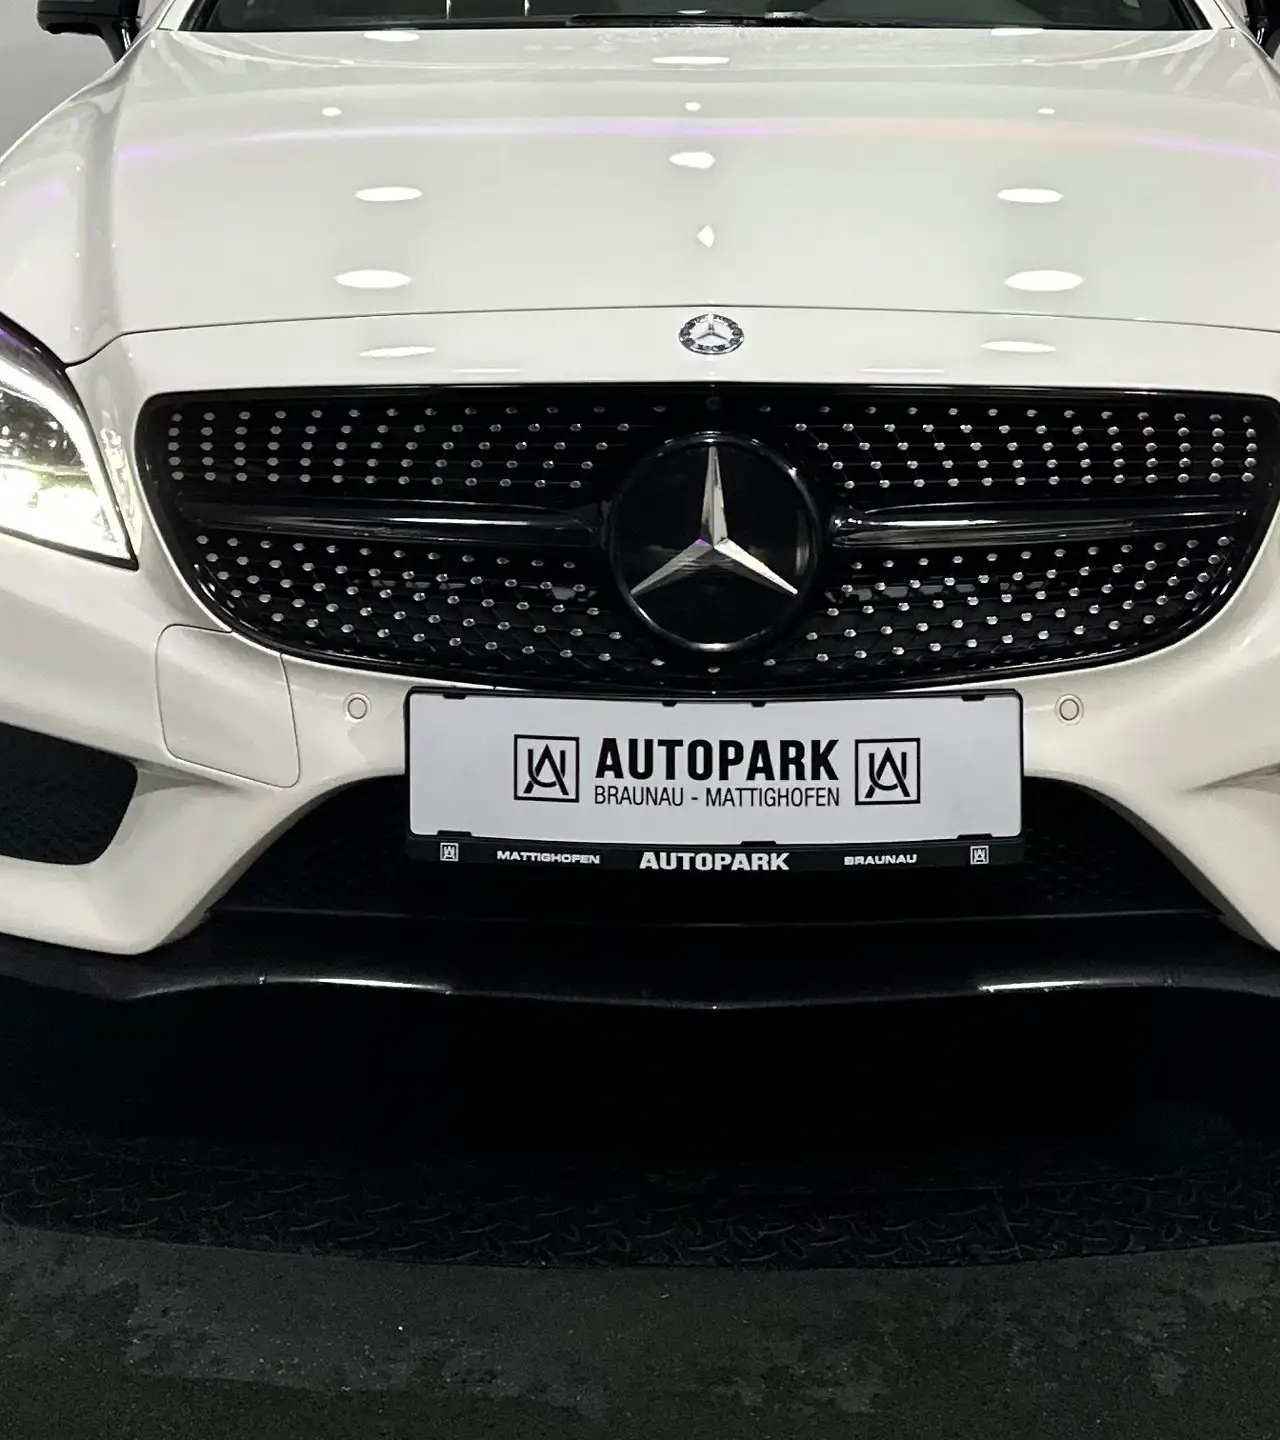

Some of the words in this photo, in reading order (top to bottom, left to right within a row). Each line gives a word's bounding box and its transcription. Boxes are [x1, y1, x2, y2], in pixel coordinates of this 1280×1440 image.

[594, 737, 840, 781] AUTOPARK
[594, 786, 684, 807] BRAUNAU
[705, 787, 840, 808] MATTIGHOFEN
[496, 850, 600, 865] MATTIGHOFEN
[639, 851, 790, 871] AUTOPARK
[843, 853, 918, 866] BRAUNAU
